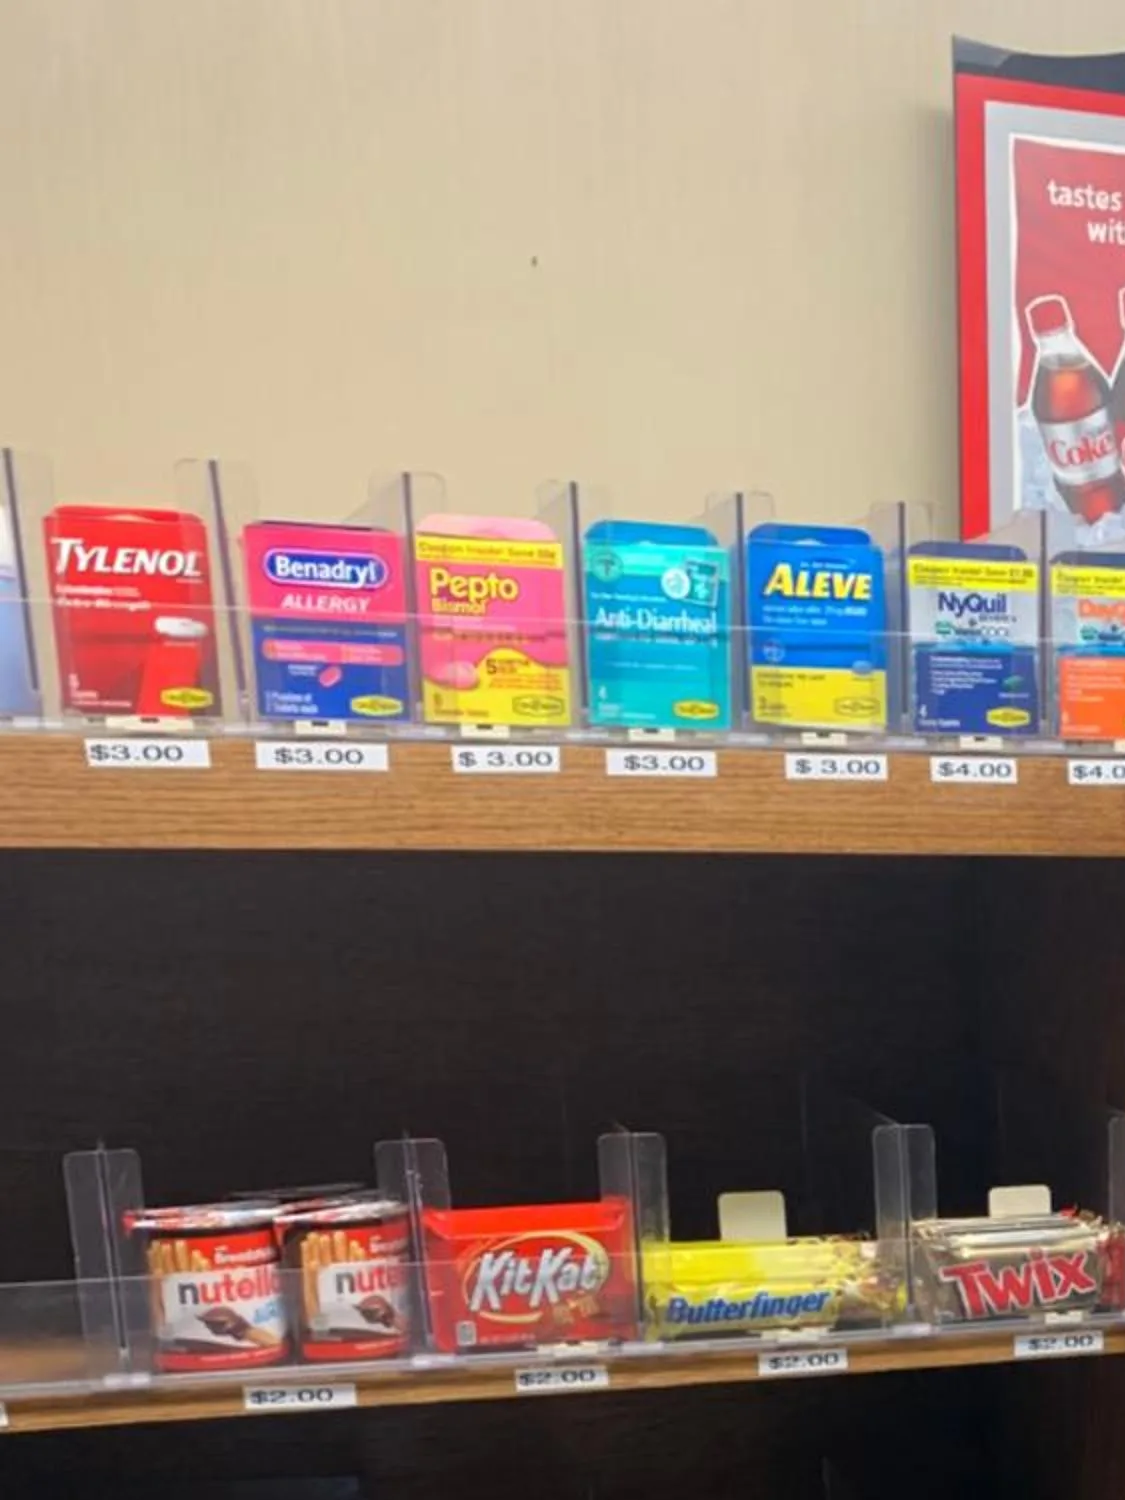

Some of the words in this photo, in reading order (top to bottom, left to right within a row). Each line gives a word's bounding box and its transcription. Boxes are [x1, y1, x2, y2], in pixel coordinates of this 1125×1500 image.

[1047, 179, 1123, 211] tastes
[51, 536, 203, 578] TYLENOL
[274, 555, 377, 586] Benadryl
[429, 568, 519, 602] Pepto
[763, 563, 873, 600] ALEVE
[281, 594, 371, 613] ALLERGY
[431, 597, 488, 616] Bismol
[937, 592, 1007, 618] NyQuil
[594, 606, 718, 635] Anti-Diarrheal
[89, 743, 184, 763] $3.00
[273, 746, 365, 766] $3.00
[622, 754, 706, 772] $3.00
[938, 761, 1013, 777] $4.00
[665, 1290, 831, 1324] Butterfinger
[1028, 1334, 1094, 1351] $2.00
[768, 1352, 840, 1369] $2.00
[518, 1369, 597, 1387] $2.00
[249, 1388, 335, 1405] $2.00
